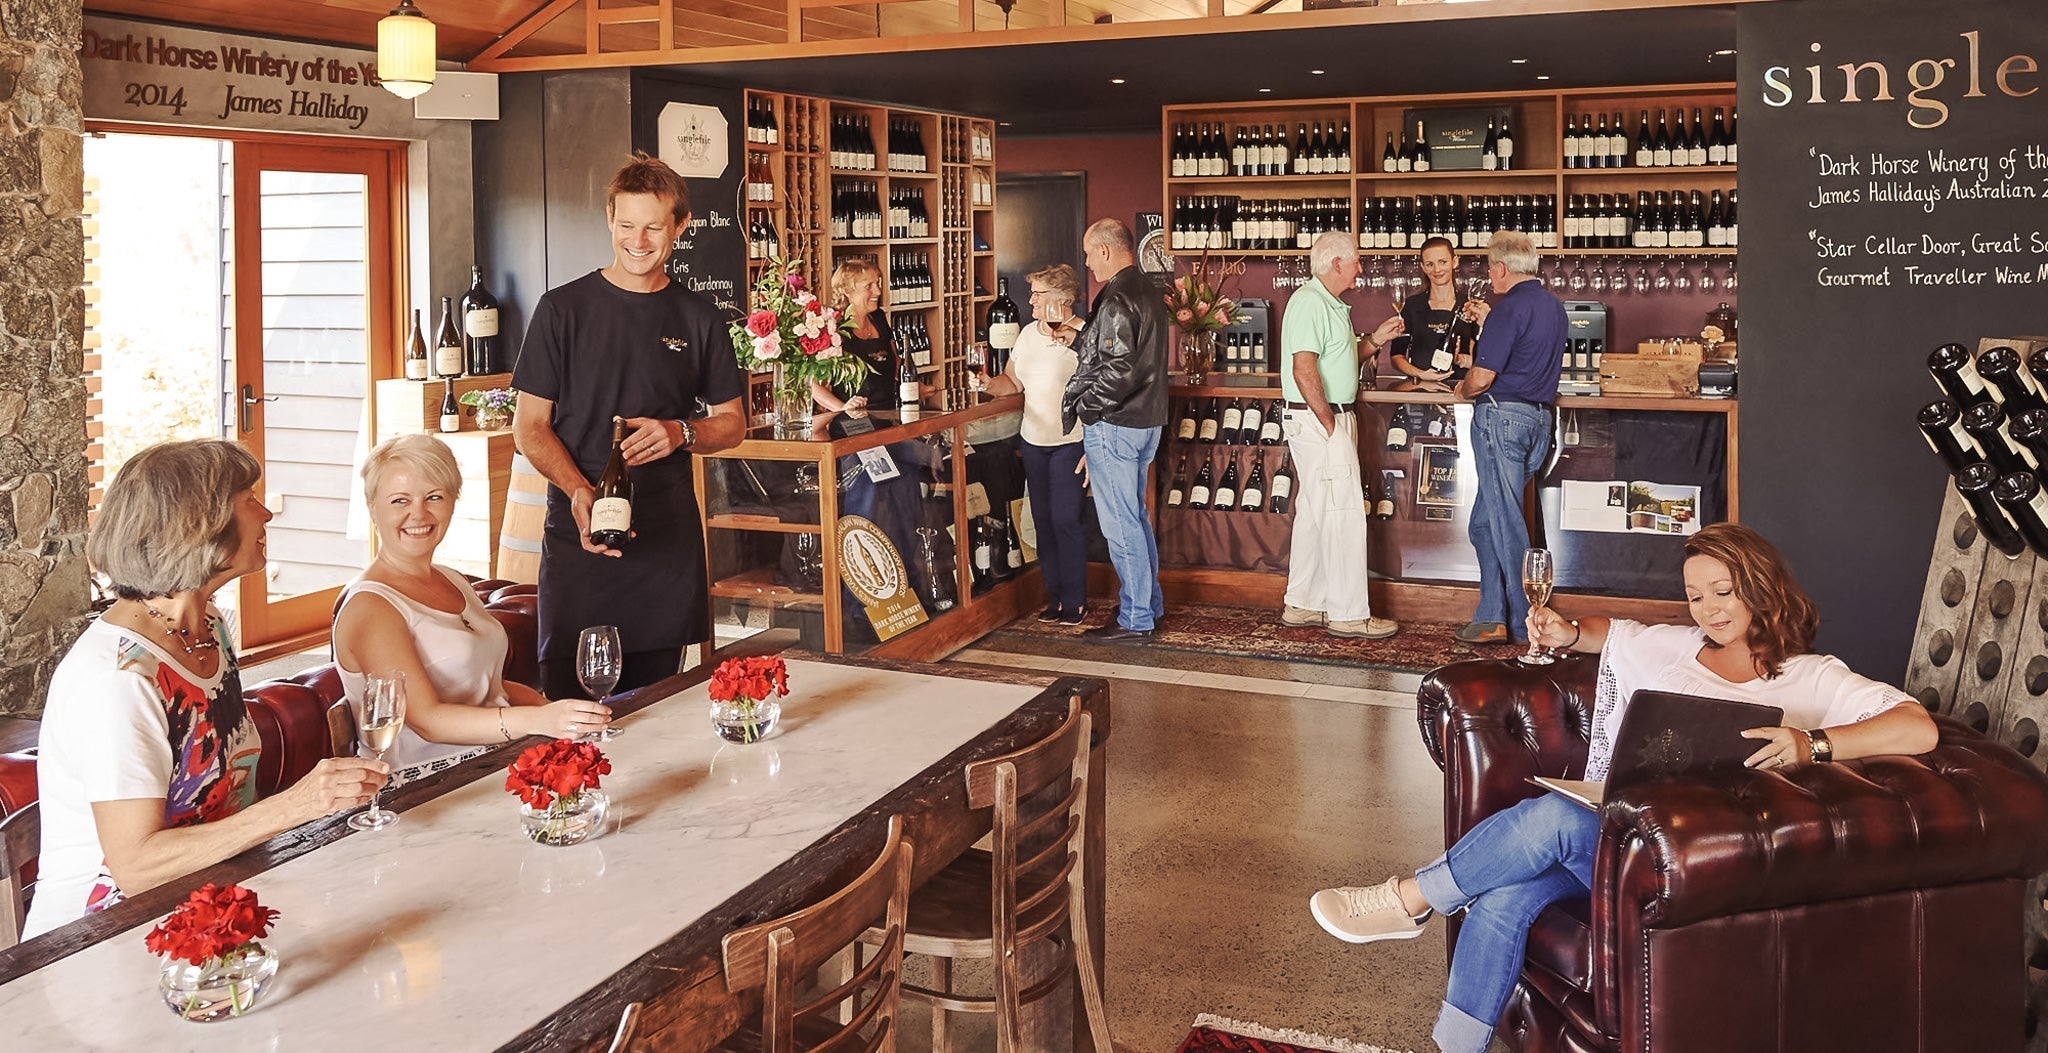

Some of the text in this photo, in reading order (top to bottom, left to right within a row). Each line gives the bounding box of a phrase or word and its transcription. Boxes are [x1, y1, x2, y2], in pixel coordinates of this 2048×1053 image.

[81, 30, 379, 88] Dark Horse Winery of the Ye
[1762, 29, 2041, 129] single
[124, 82, 370, 130] 2014 James Halliday
[1870, 153, 1920, 175] Horse
[1927, 149, 1989, 182] Winery
[1999, 148, 2017, 179] of
[2024, 144, 2048, 170] th
[1808, 185, 1861, 209] James
[1869, 180, 1942, 213] Halliday's
[1946, 177, 2037, 200] Australian
[710, 210, 731, 228] Blanc
[1865, 235, 1918, 255] Cellar
[1921, 234, 1966, 257] Door,
[1971, 232, 2022, 253] Great
[673, 258, 689, 274] Gris
[1817, 266, 1891, 287] Gourmet
[1904, 265, 1987, 285] Traveller
[1995, 266, 2033, 285] Wine
[687, 275, 733, 298] Chardonnay
[887, 602, 901, 614] 2014
[887, 610, 904, 624] HORSE
[888, 623, 896, 633] OF
